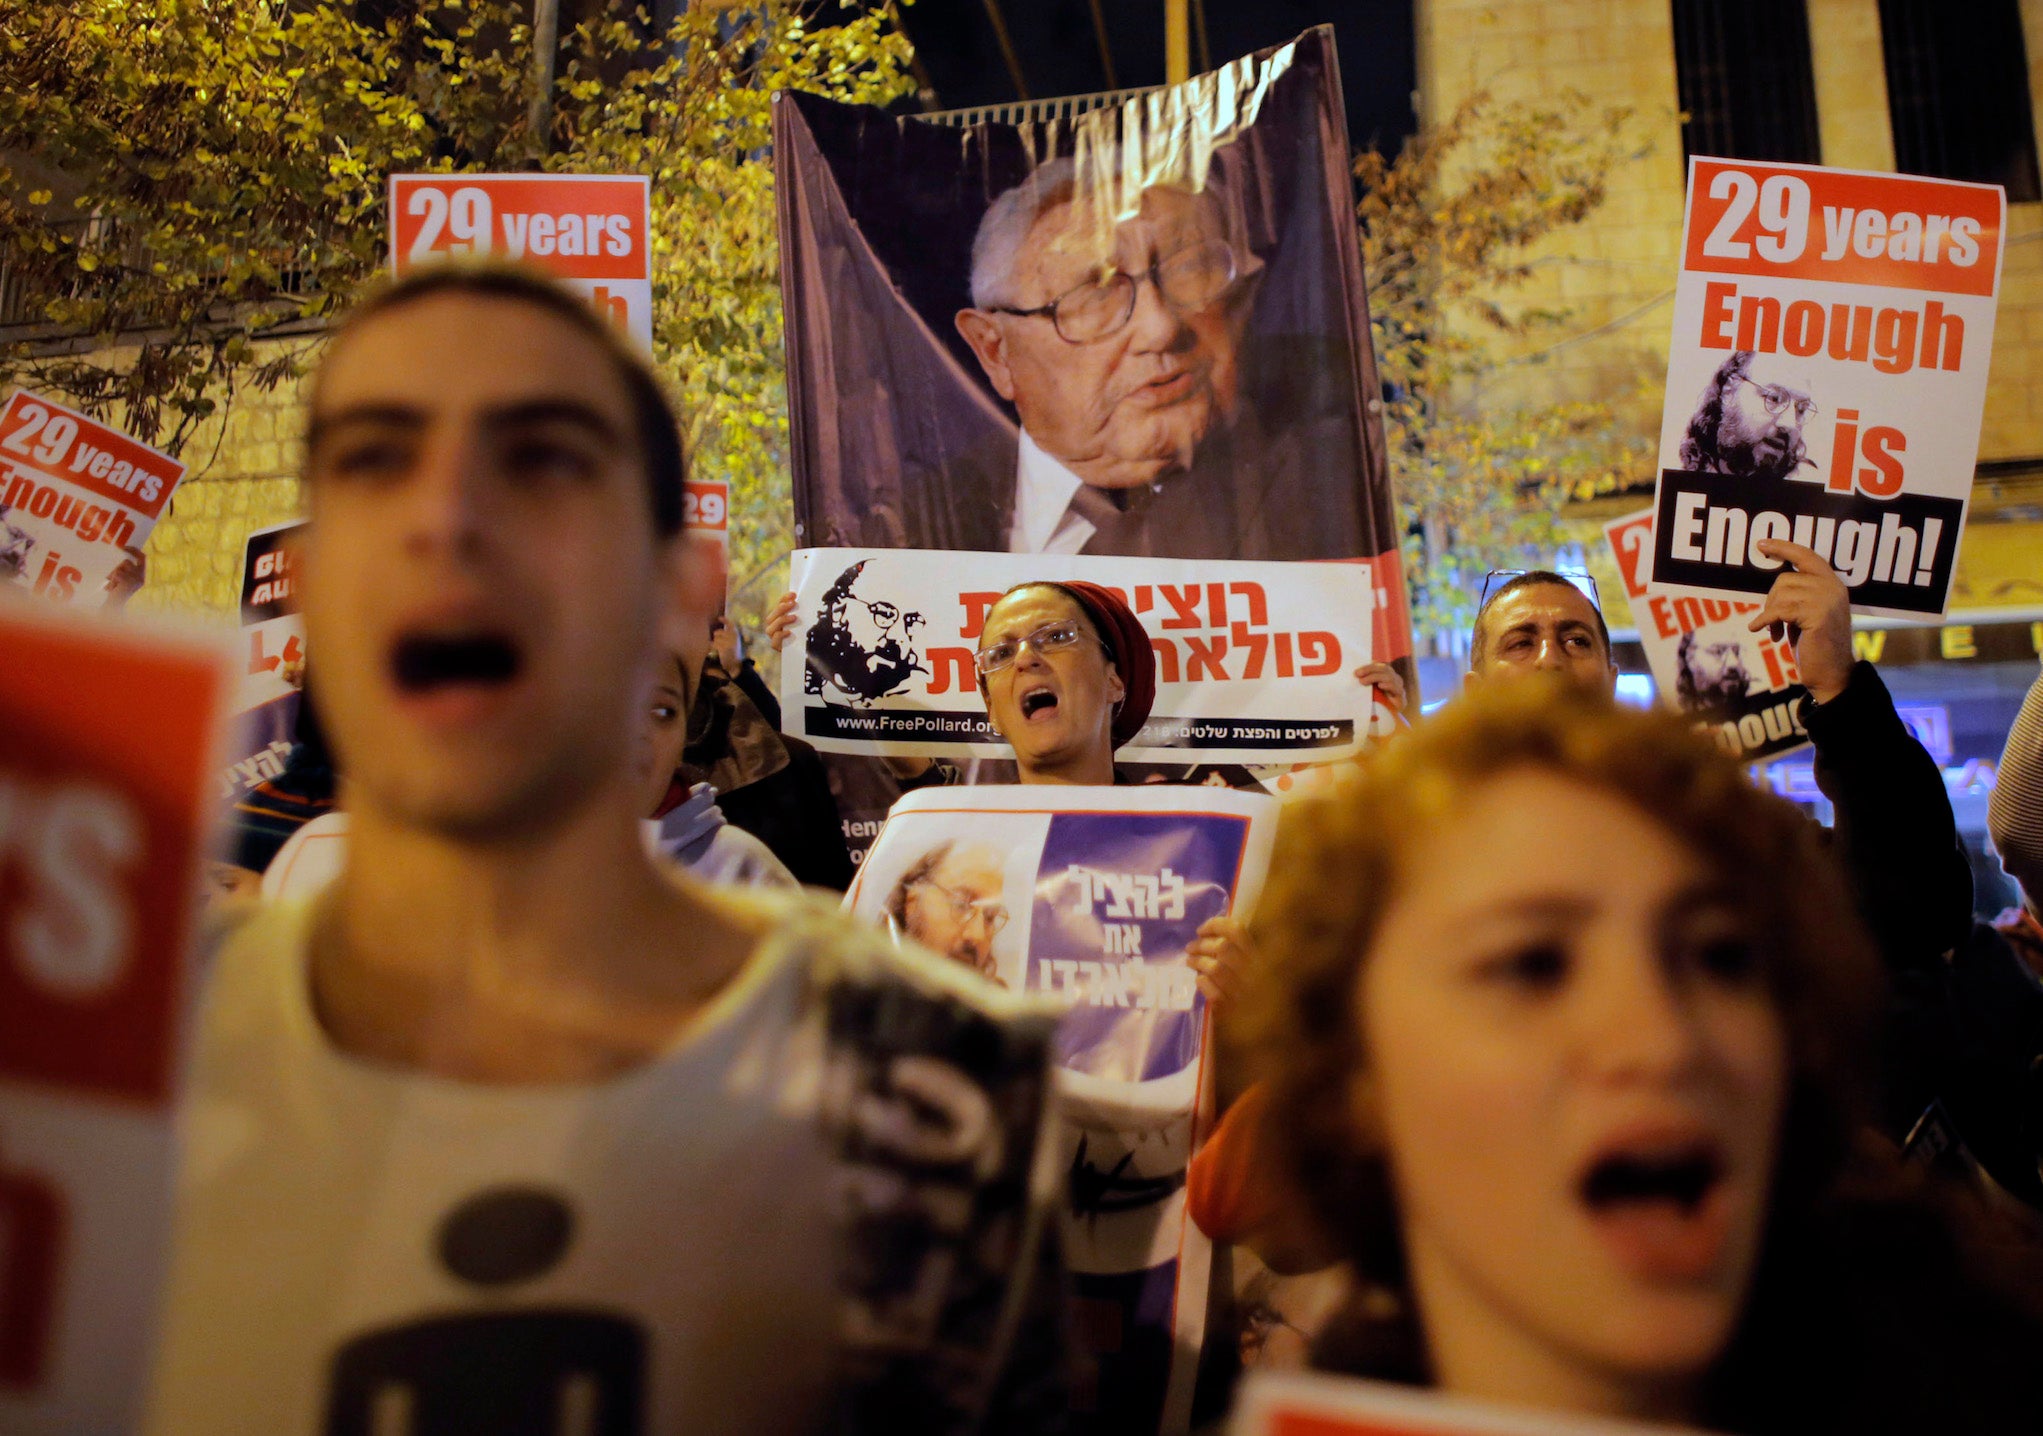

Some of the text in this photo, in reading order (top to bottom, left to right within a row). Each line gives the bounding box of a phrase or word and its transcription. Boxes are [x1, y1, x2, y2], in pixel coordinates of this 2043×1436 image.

[408, 187, 632, 263] 29 years
[1703, 171, 1983, 268] 29 years
[1700, 282, 1966, 374] Enough
[1, 403, 164, 502] 29 years
[1828, 409, 1907, 497] is
[1232, 726, 1281, 740] והפצת
[1285, 725, 1341, 740] לפרטים
[1068, 864, 1184, 920] להציל
[1103, 923, 1143, 955] את
